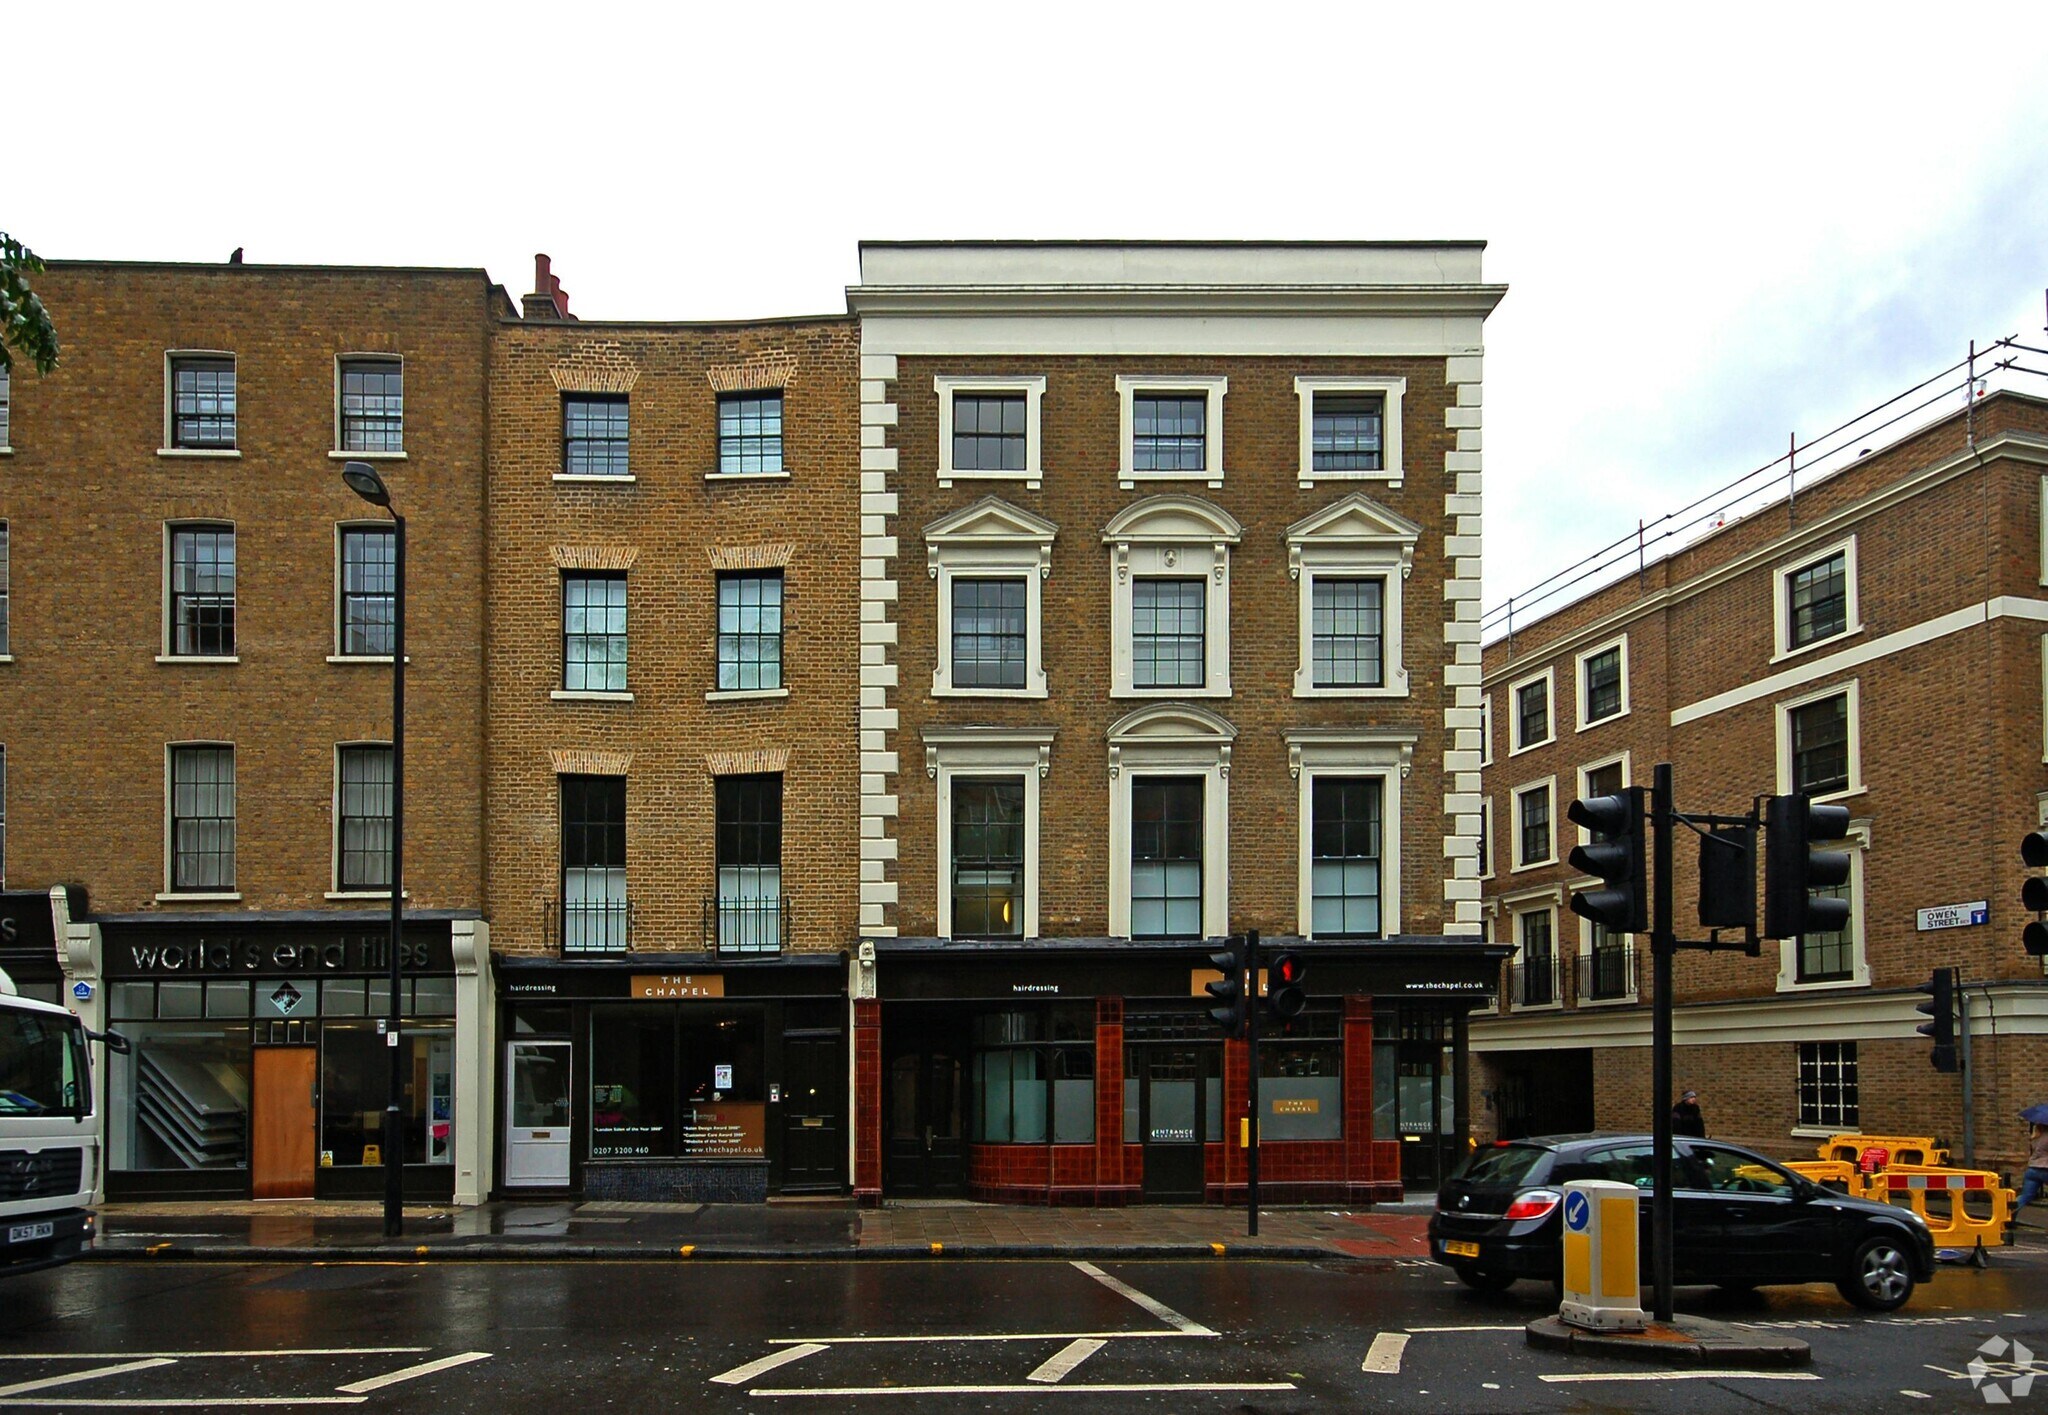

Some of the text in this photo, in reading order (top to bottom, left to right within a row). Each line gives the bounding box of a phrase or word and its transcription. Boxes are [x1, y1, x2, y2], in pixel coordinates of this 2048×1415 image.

[1927, 910, 1958, 921] OWEN
[1927, 917, 1960, 928] STREET
[131, 937, 429, 969] world's end tiles
[661, 976, 692, 984] THE
[510, 984, 556, 993] hairdressing
[1012, 984, 1059, 993] hairdressing
[1405, 981, 1484, 990] www.thechapel.co.uk
[645, 987, 709, 996] CHAPEL
[593, 1146, 650, 1155] 0207 5200 460
[685, 1146, 763, 1154] www.thechapel.co.uk
